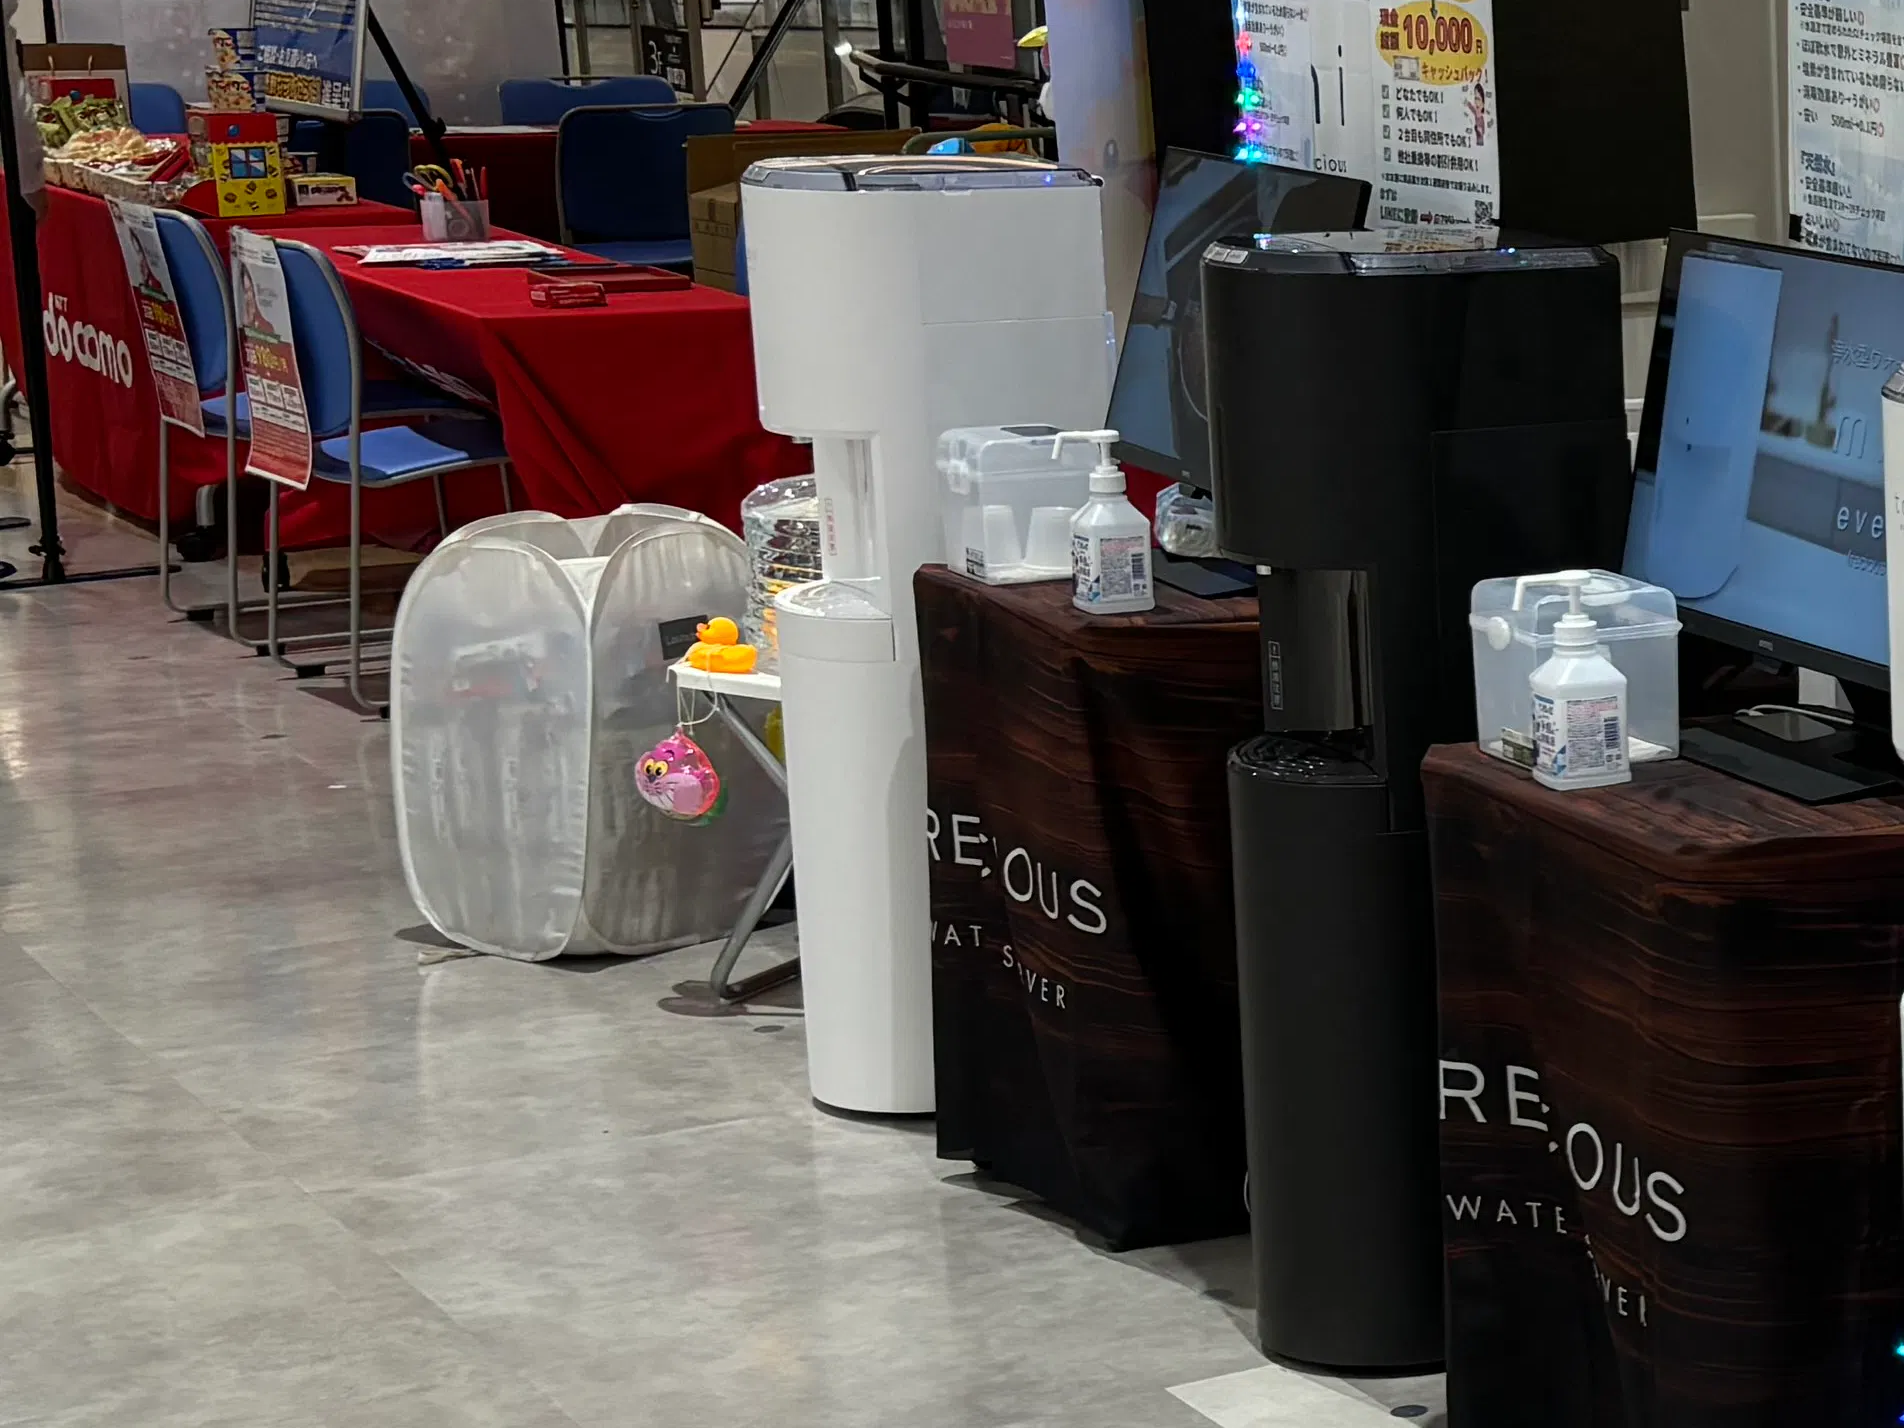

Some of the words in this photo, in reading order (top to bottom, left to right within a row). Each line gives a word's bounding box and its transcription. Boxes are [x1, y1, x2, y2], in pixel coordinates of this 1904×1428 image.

[1315, 154, 1347, 173] cious
[43, 291, 133, 388] docomo
[1837, 506, 1884, 539] eve
[1446, 1194, 1568, 1235] WATE
